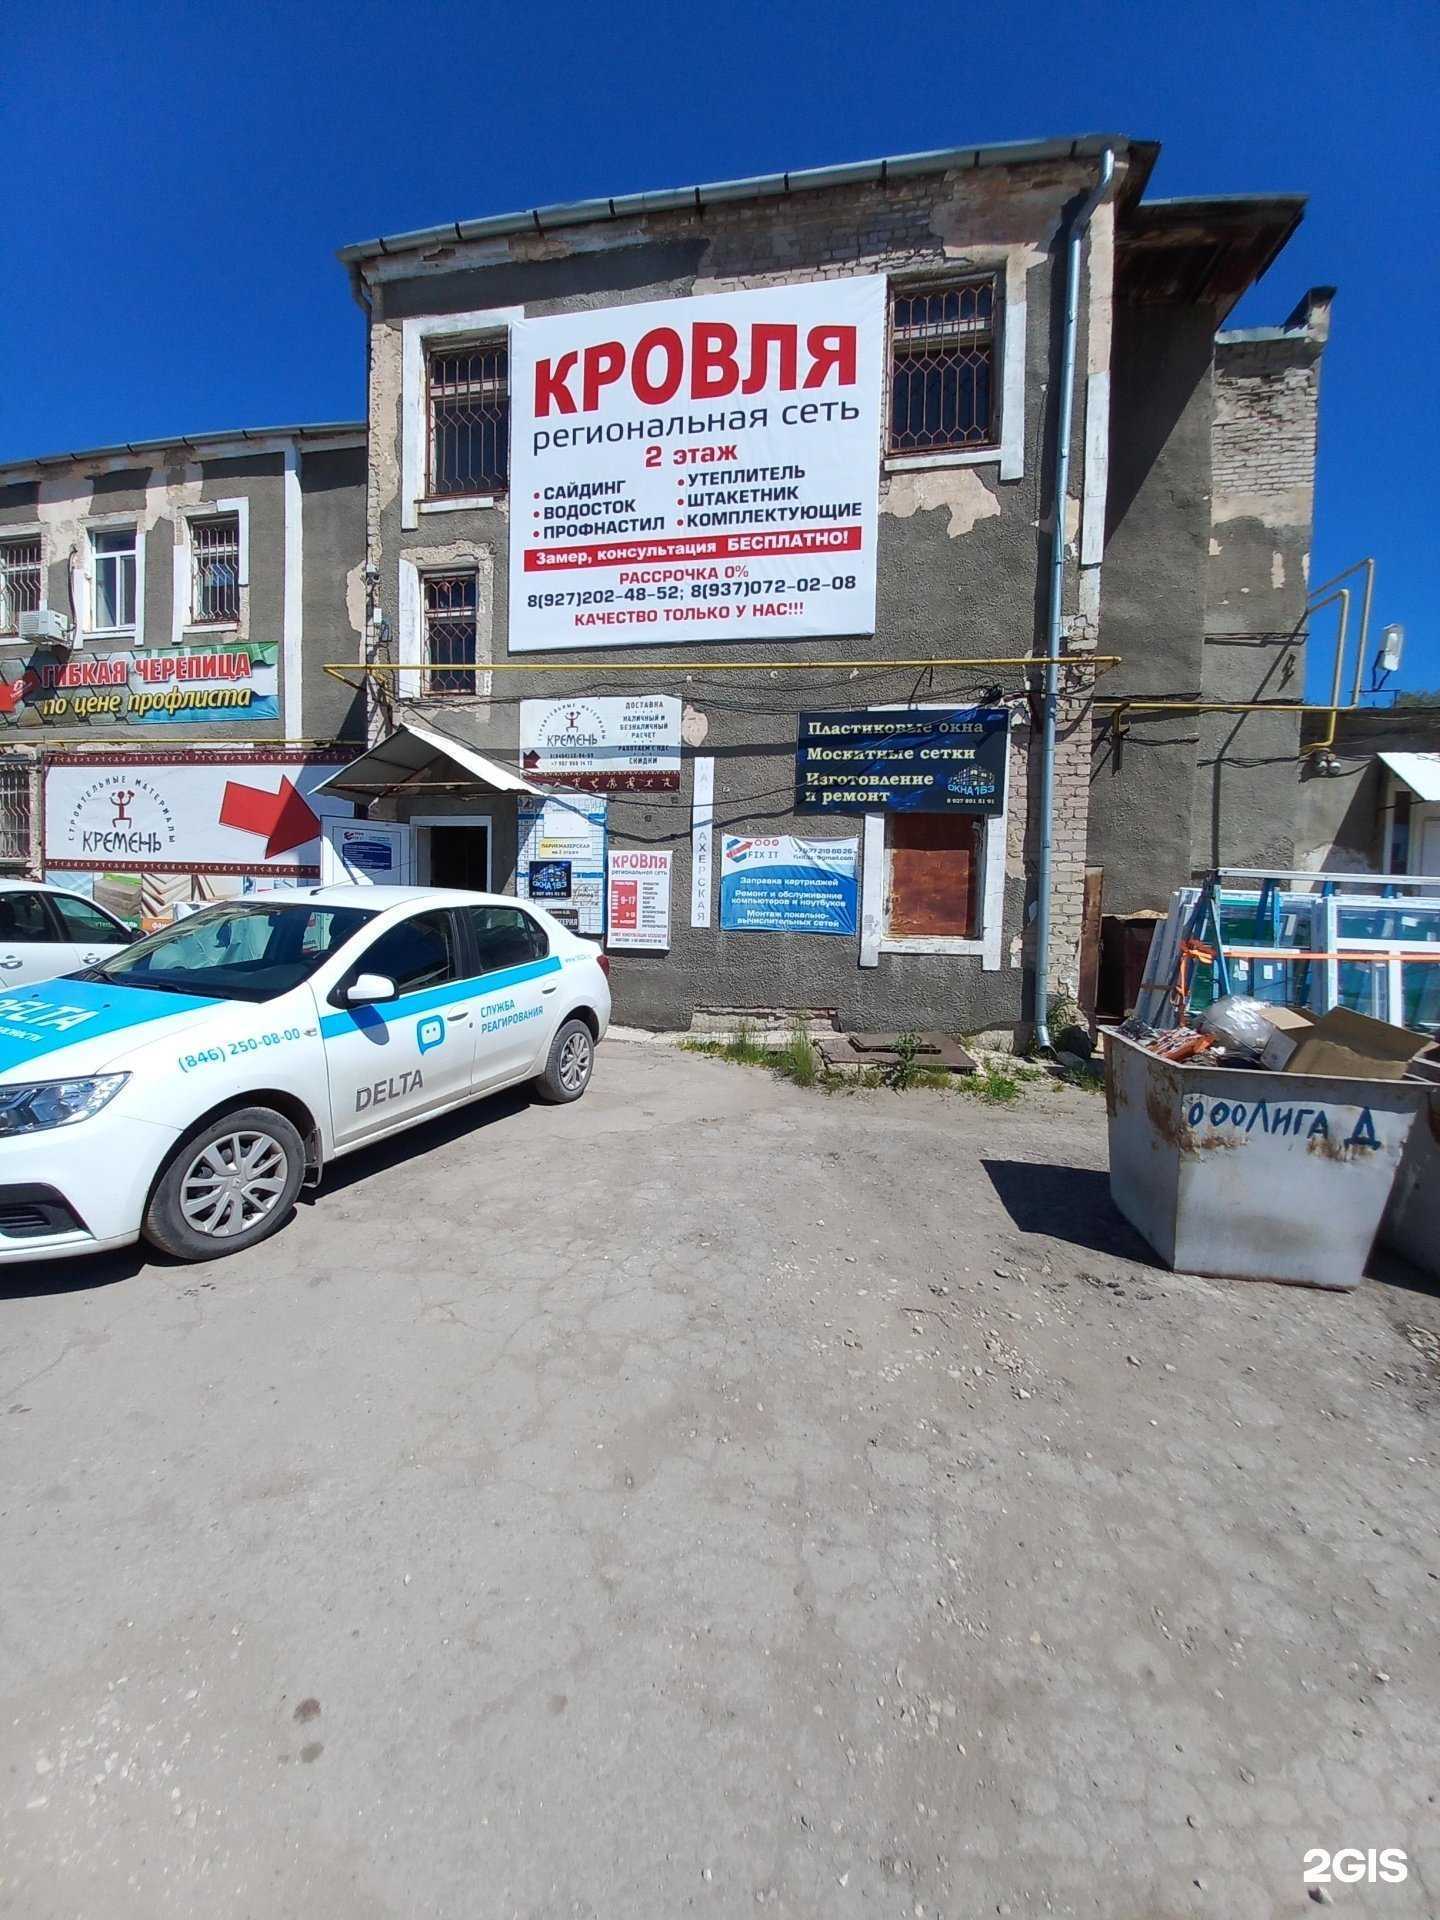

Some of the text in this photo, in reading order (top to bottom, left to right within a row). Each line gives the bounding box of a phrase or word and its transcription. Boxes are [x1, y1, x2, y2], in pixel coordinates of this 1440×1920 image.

[534, 321, 857, 417] КРОВЛЯ
[533, 400, 860, 456] региональная сеть
[645, 444, 738, 468] 2 этаж
[688, 464, 805, 488] УТЕПЛИТЕЛЬ
[543, 479, 626, 502] САЙДИНГ
[687, 486, 799, 507] ШТАКЕТНИК
[543, 499, 636, 521] ВОДОСТОК
[687, 502, 862, 528] КОМПЛЕКТУЮЩИЕ
[543, 517, 665, 540] ПРОФНАСТИЛ
[536, 531, 848, 567] Замер, консультация БЕСПЛАТНО!
[620, 565, 749, 585] РАССРОЧКА 0%
[690, 575, 857, 599] 8(937)072-02-08
[575, 602, 804, 627] КАЧЕСТВО ТОЛЬКО У НАС!!!
[41, 653, 252, 688] ГИБКАЯ ЧЕРЕПИЦА
[43, 686, 252, 717] по цене профлиста
[625, 701, 664, 709] ДОСТАВКА
[808, 722, 984, 735] Пластиковые окна
[547, 734, 598, 747] КРЕМЕНЬ
[806, 747, 976, 761] Москитные сетки
[806, 772, 934, 785] Изготовление
[68, 775, 176, 843] СТРОИТЕЛЬНЫЕ МАТЕРИАЛЫ
[805, 791, 890, 805] и ремонт
[83, 831, 162, 853] КРЕМЕНЬ
[755, 839, 780, 847] ООО
[612, 853, 667, 869] КРОВЛЯ
[735, 889, 767, 898] Ремонт
[740, 877, 839, 887] Заправка картриджей
[480, 999, 516, 1018] СЛУЖБА
[481, 1006, 544, 1033] РЕАГИРОВАНИЯ
[178, 1028, 301, 1073] (846) 250-08-00
[355, 1069, 424, 1112] DELTA
[1344, 1106, 1382, 1150] Д
